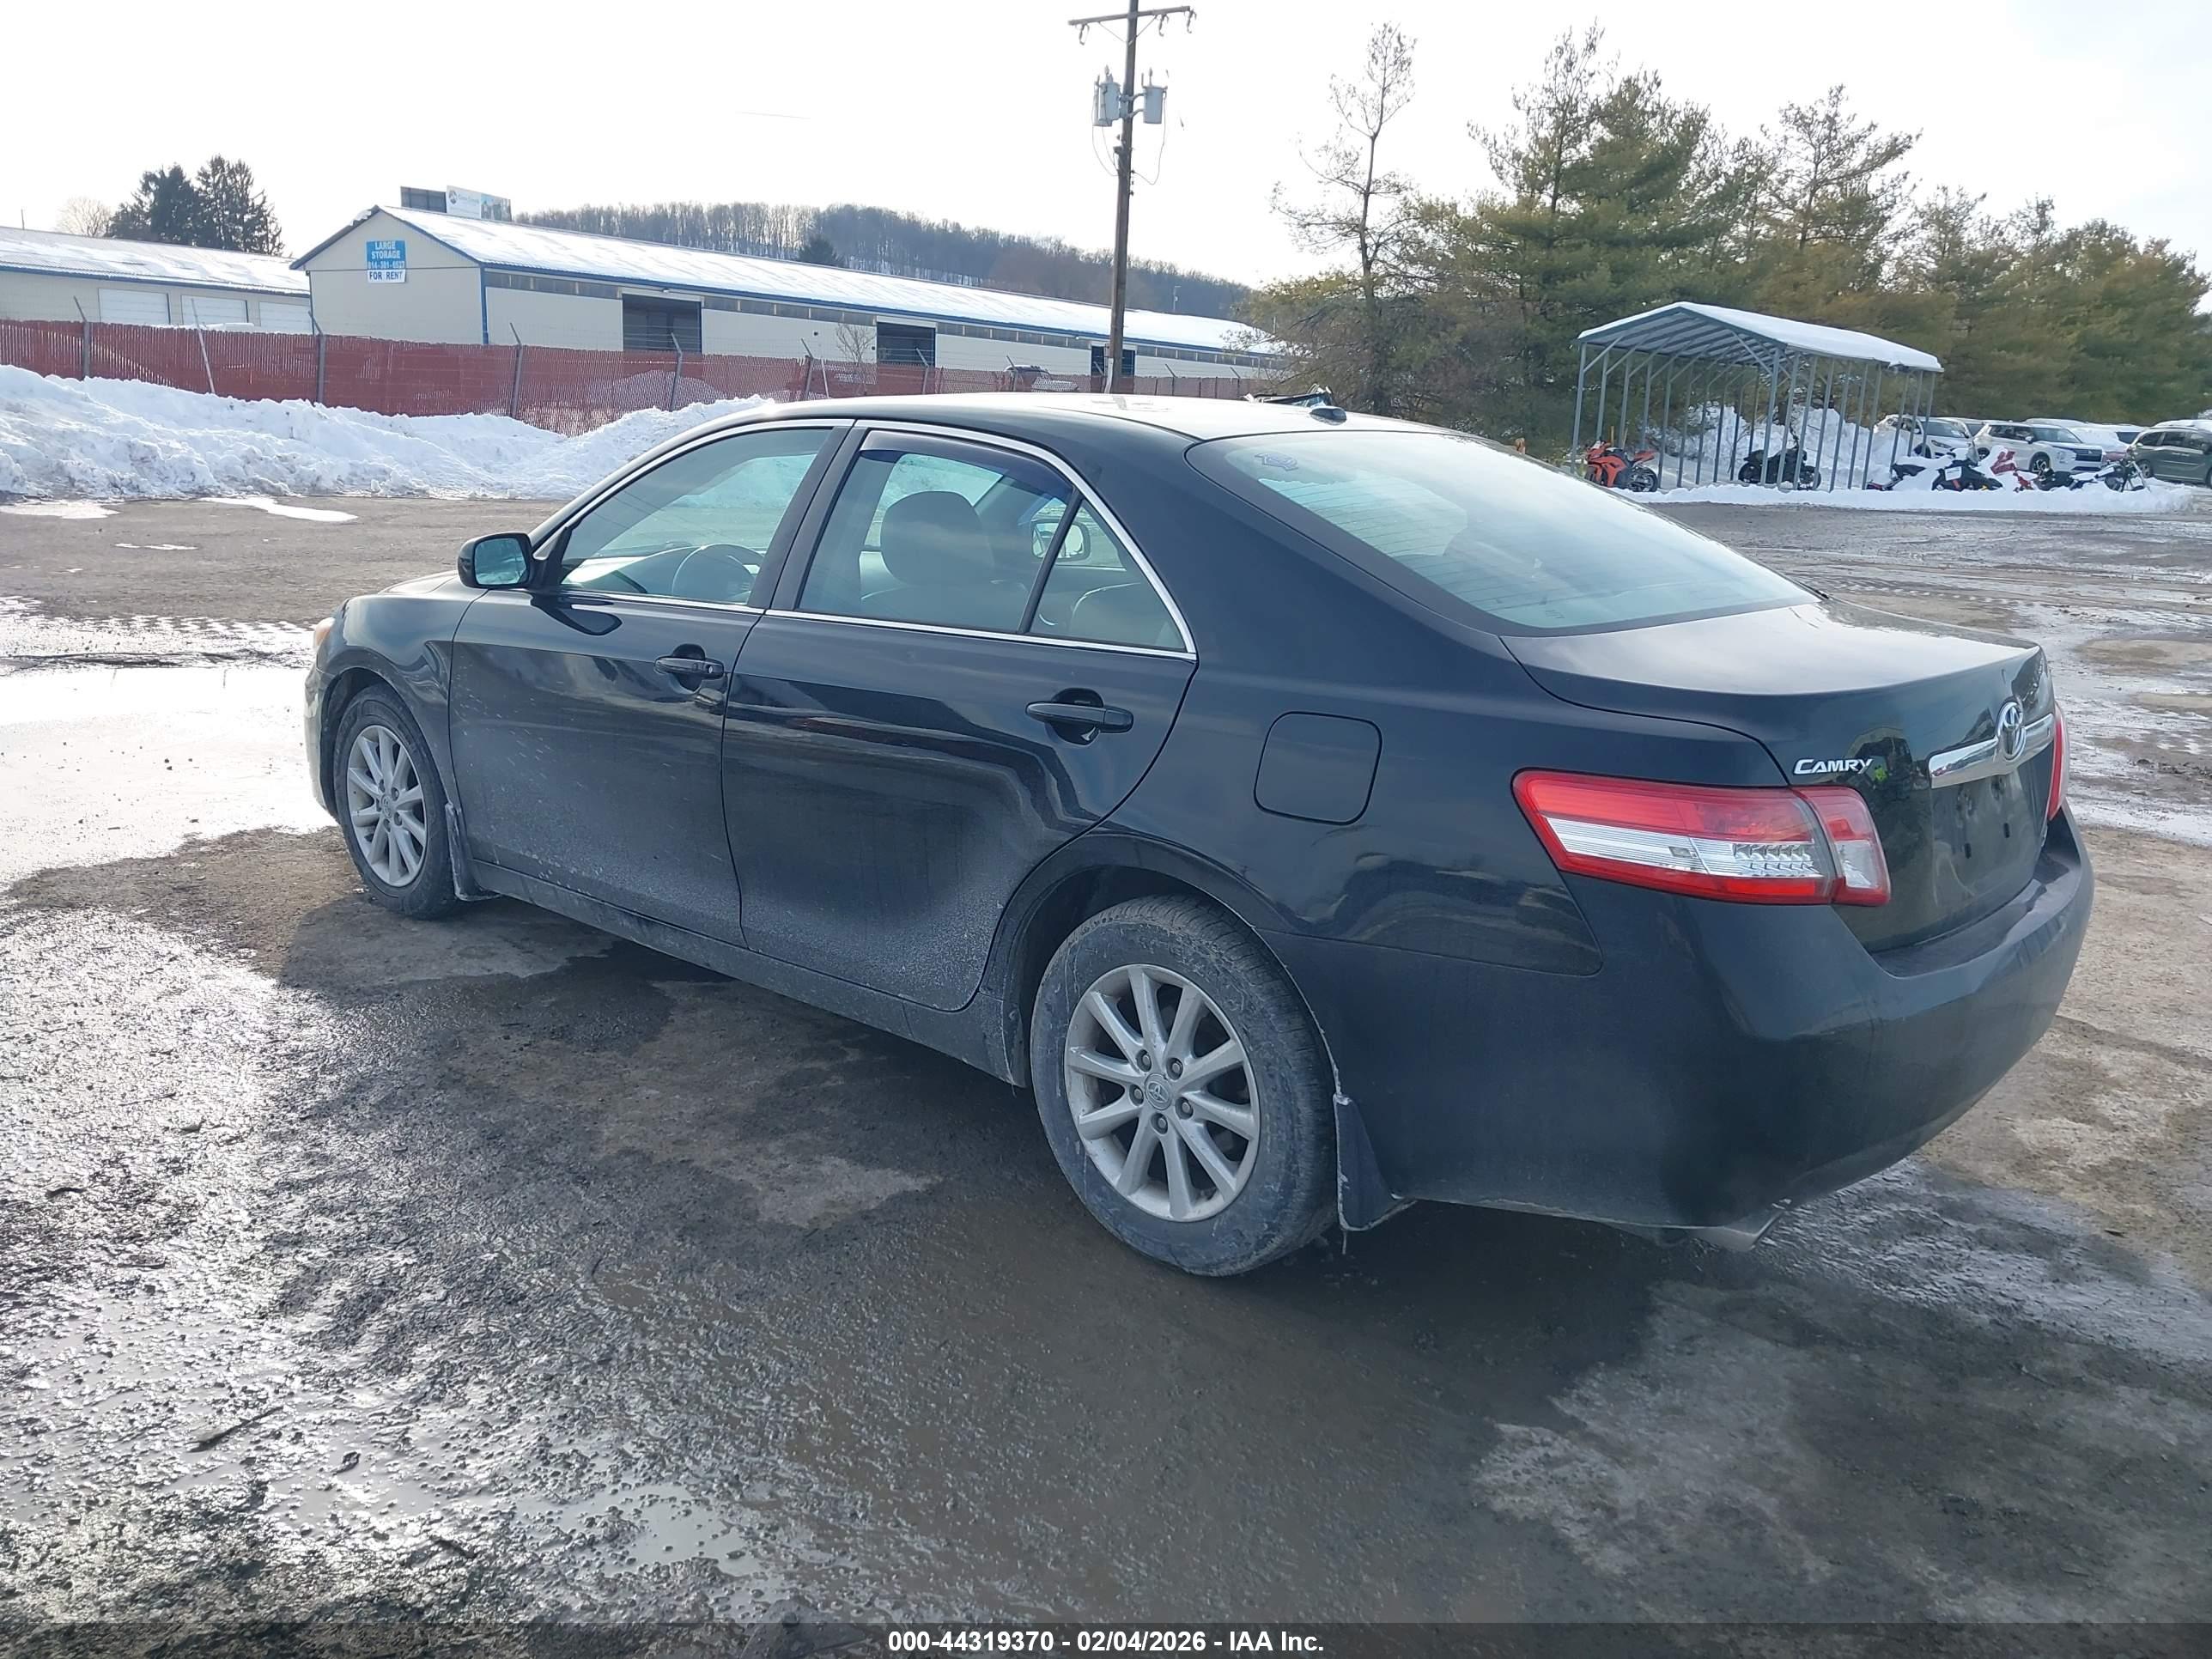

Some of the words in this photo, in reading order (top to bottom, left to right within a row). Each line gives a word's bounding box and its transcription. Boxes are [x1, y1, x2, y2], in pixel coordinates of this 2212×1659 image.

[374, 241, 396, 250] LARGE
[371, 250, 401, 259] STORAGE
[369, 270, 383, 280] FOR
[386, 270, 403, 280] RENT
[1793, 758, 1874, 775] CAMRY
